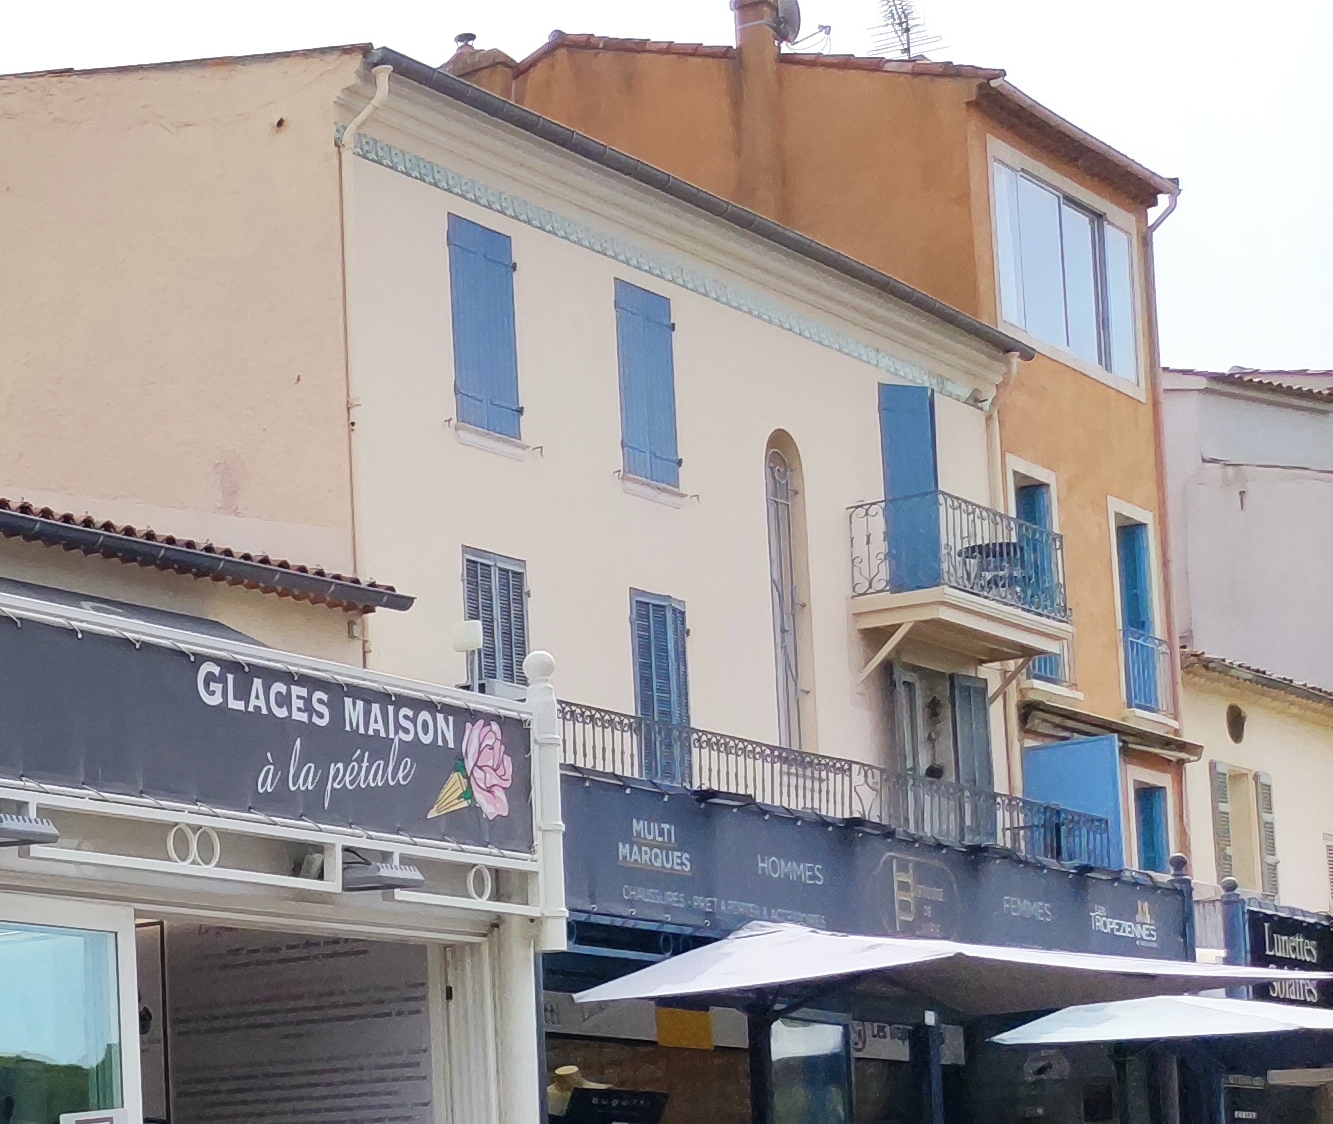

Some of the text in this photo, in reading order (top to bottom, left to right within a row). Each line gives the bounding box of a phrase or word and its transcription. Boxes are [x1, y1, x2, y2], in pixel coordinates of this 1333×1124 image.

[196, 661, 455, 749] GLACES MAISON
[257, 735, 417, 811] à la pétale
[632, 818, 676, 844] MULTI
[618, 841, 692, 872] MARQUES
[757, 854, 825, 886] HOMMES
[1003, 895, 1053, 922] FEMMES
[1264, 922, 1318, 964] Lunettes
